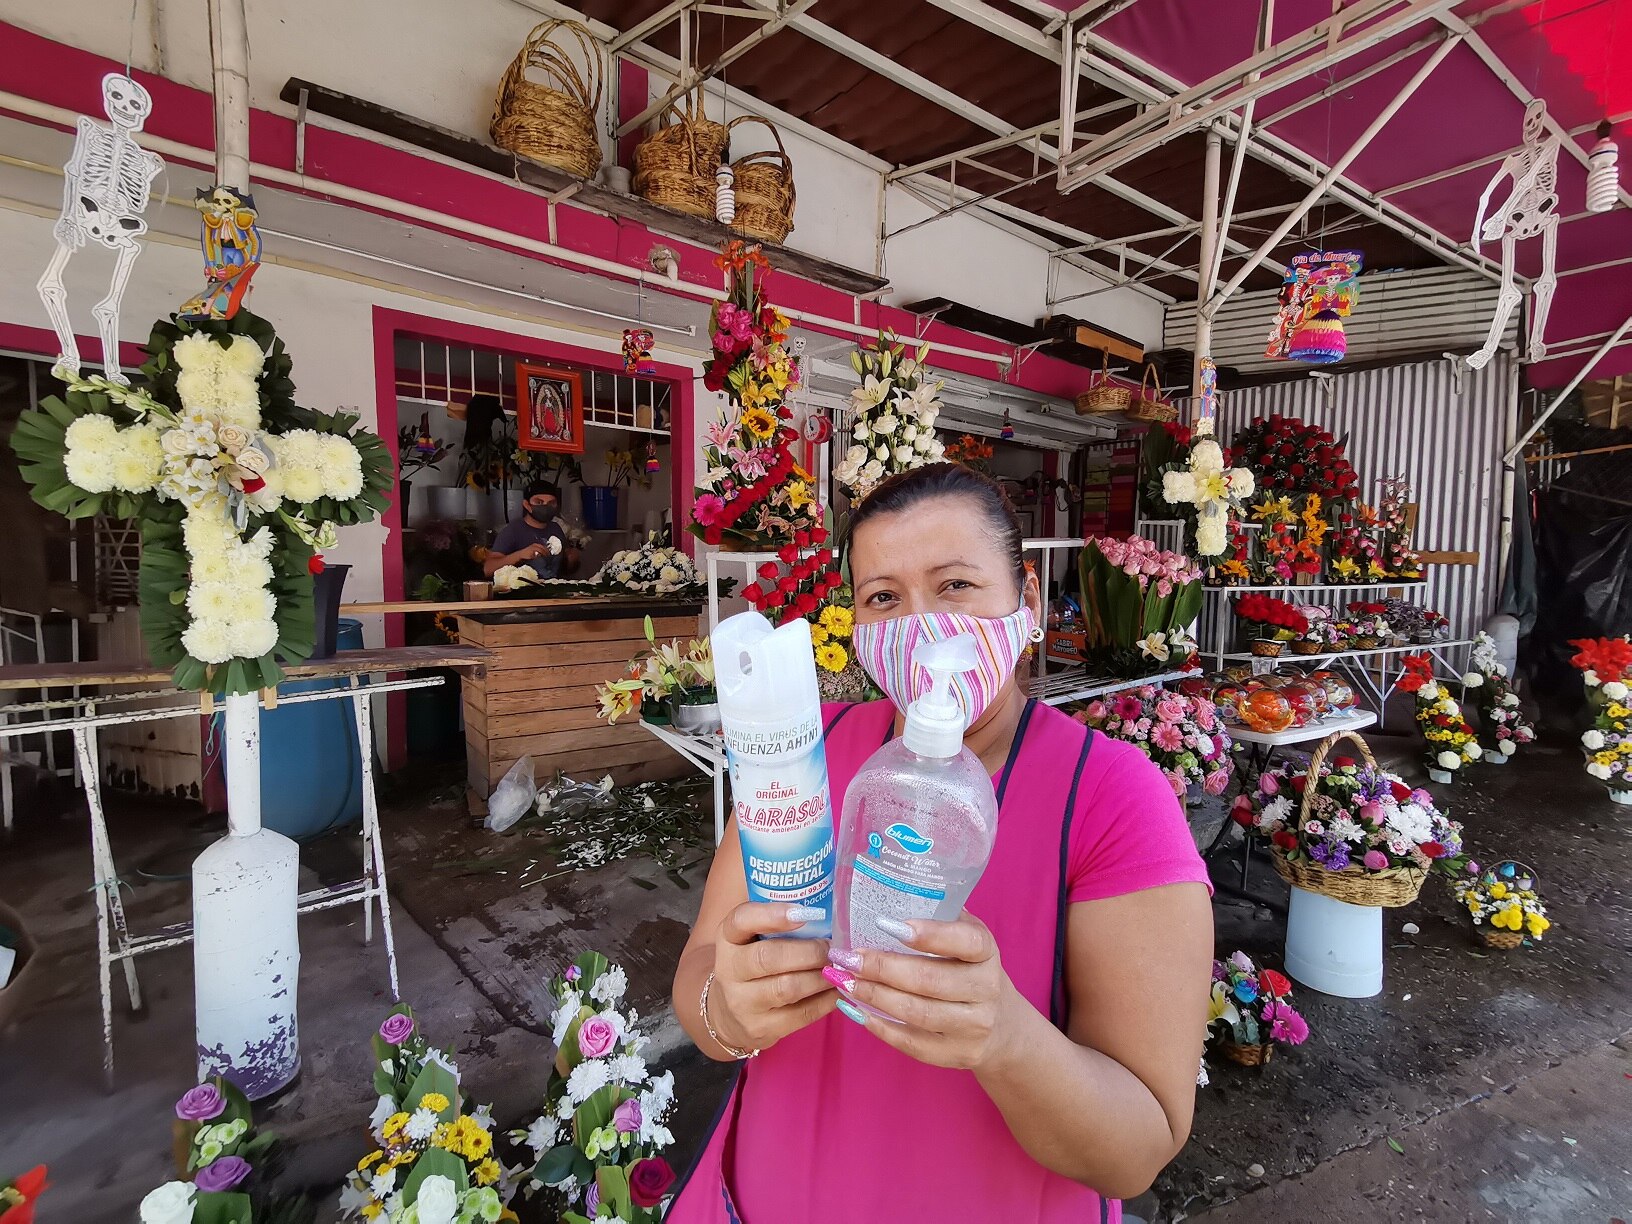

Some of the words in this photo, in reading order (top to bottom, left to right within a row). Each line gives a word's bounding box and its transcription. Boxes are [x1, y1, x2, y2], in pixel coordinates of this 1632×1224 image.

[724, 724, 752, 742] ELIMINA
[755, 734, 766, 742] EL
[769, 727, 798, 741] VIRUS
[800, 720, 810, 734] DE
[725, 735, 782, 755] INFLUENZA
[785, 726, 819, 752] AH1N1
[755, 787, 799, 799] ORIGINAL
[770, 781, 781, 790] EL
[737, 789, 826, 827] CLARASOL
[873, 837, 878, 845] 1
[887, 828, 932, 847] blumen
[749, 835, 834, 874] DESINFECCIÓN
[881, 845, 911, 861] Coconut
[911, 855, 940, 868] Water
[750, 863, 825, 887] AMBIENTAL
[910, 864, 932, 873] MANGO
[914, 870, 927, 878] PARA
[769, 891, 798, 899] Elimina
[807, 880, 828, 895] 99.9%
